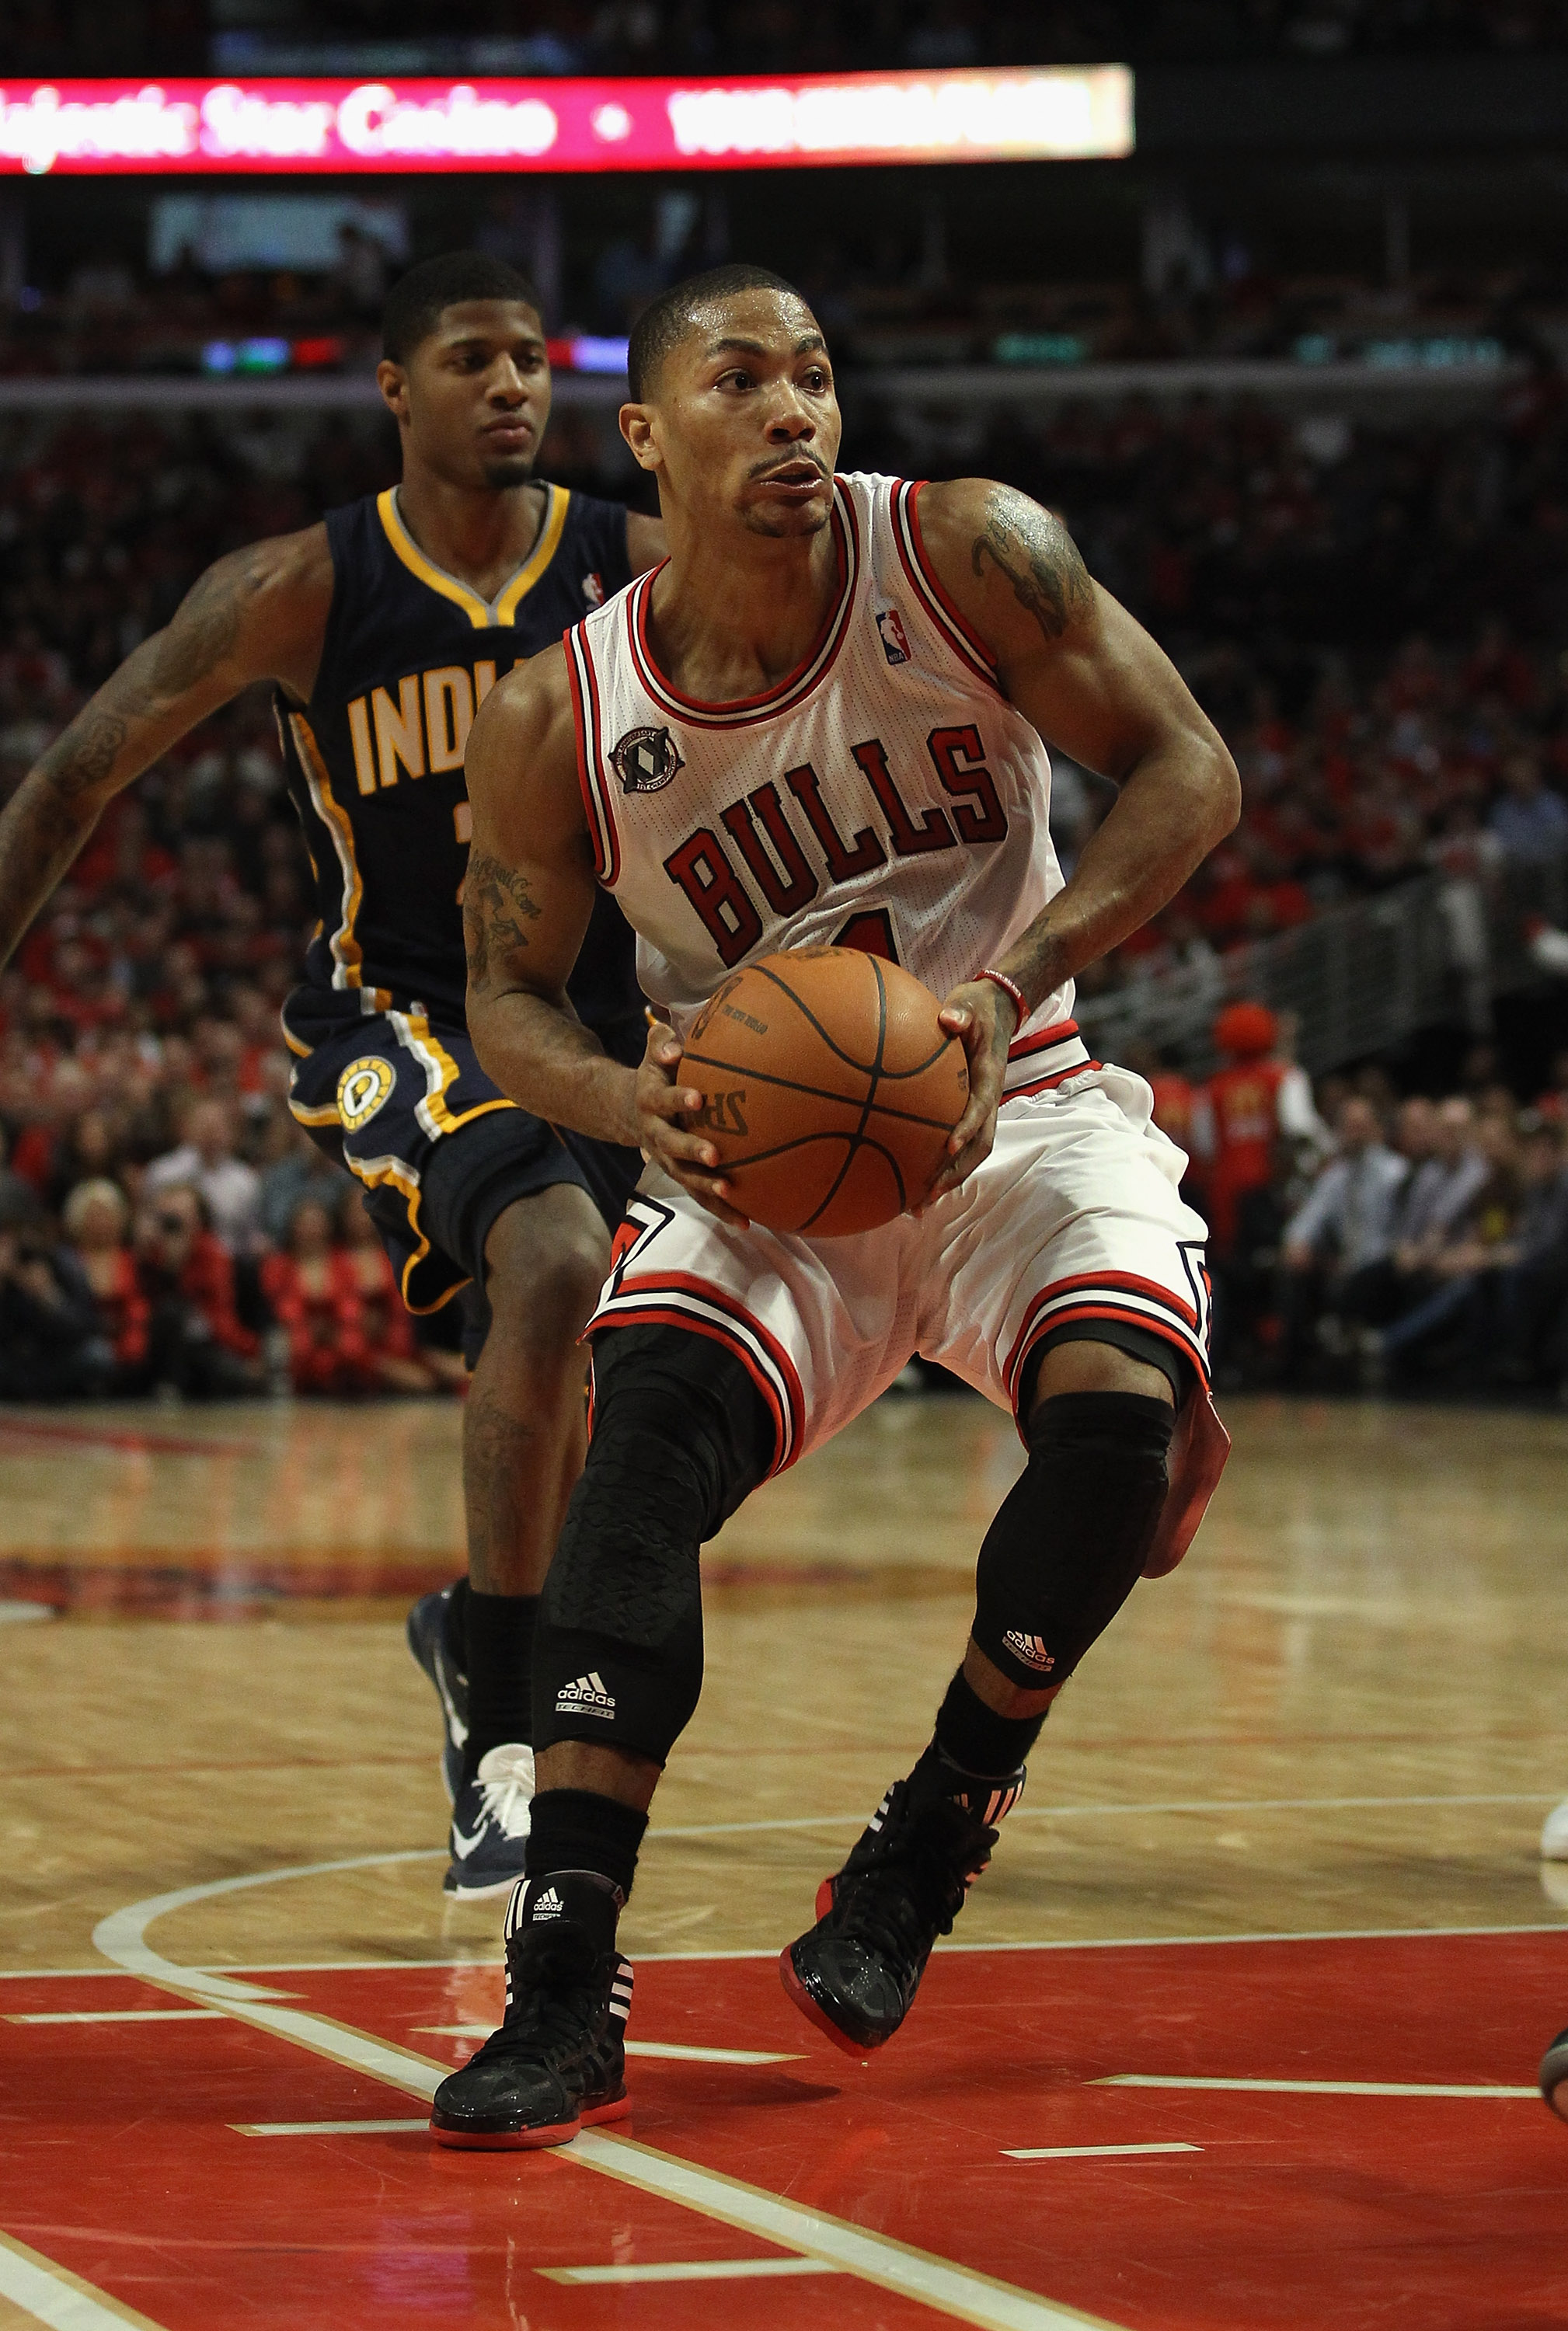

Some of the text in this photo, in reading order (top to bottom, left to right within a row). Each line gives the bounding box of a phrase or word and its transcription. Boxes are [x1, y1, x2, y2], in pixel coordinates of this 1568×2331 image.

[200, 84, 335, 157] Star
[336, 84, 558, 156] Casino
[662, 723, 1009, 970] BULLS
[1007, 1630, 1055, 1664] adidas
[557, 1688, 616, 1707] adidas
[533, 1902, 563, 1911] adidas
